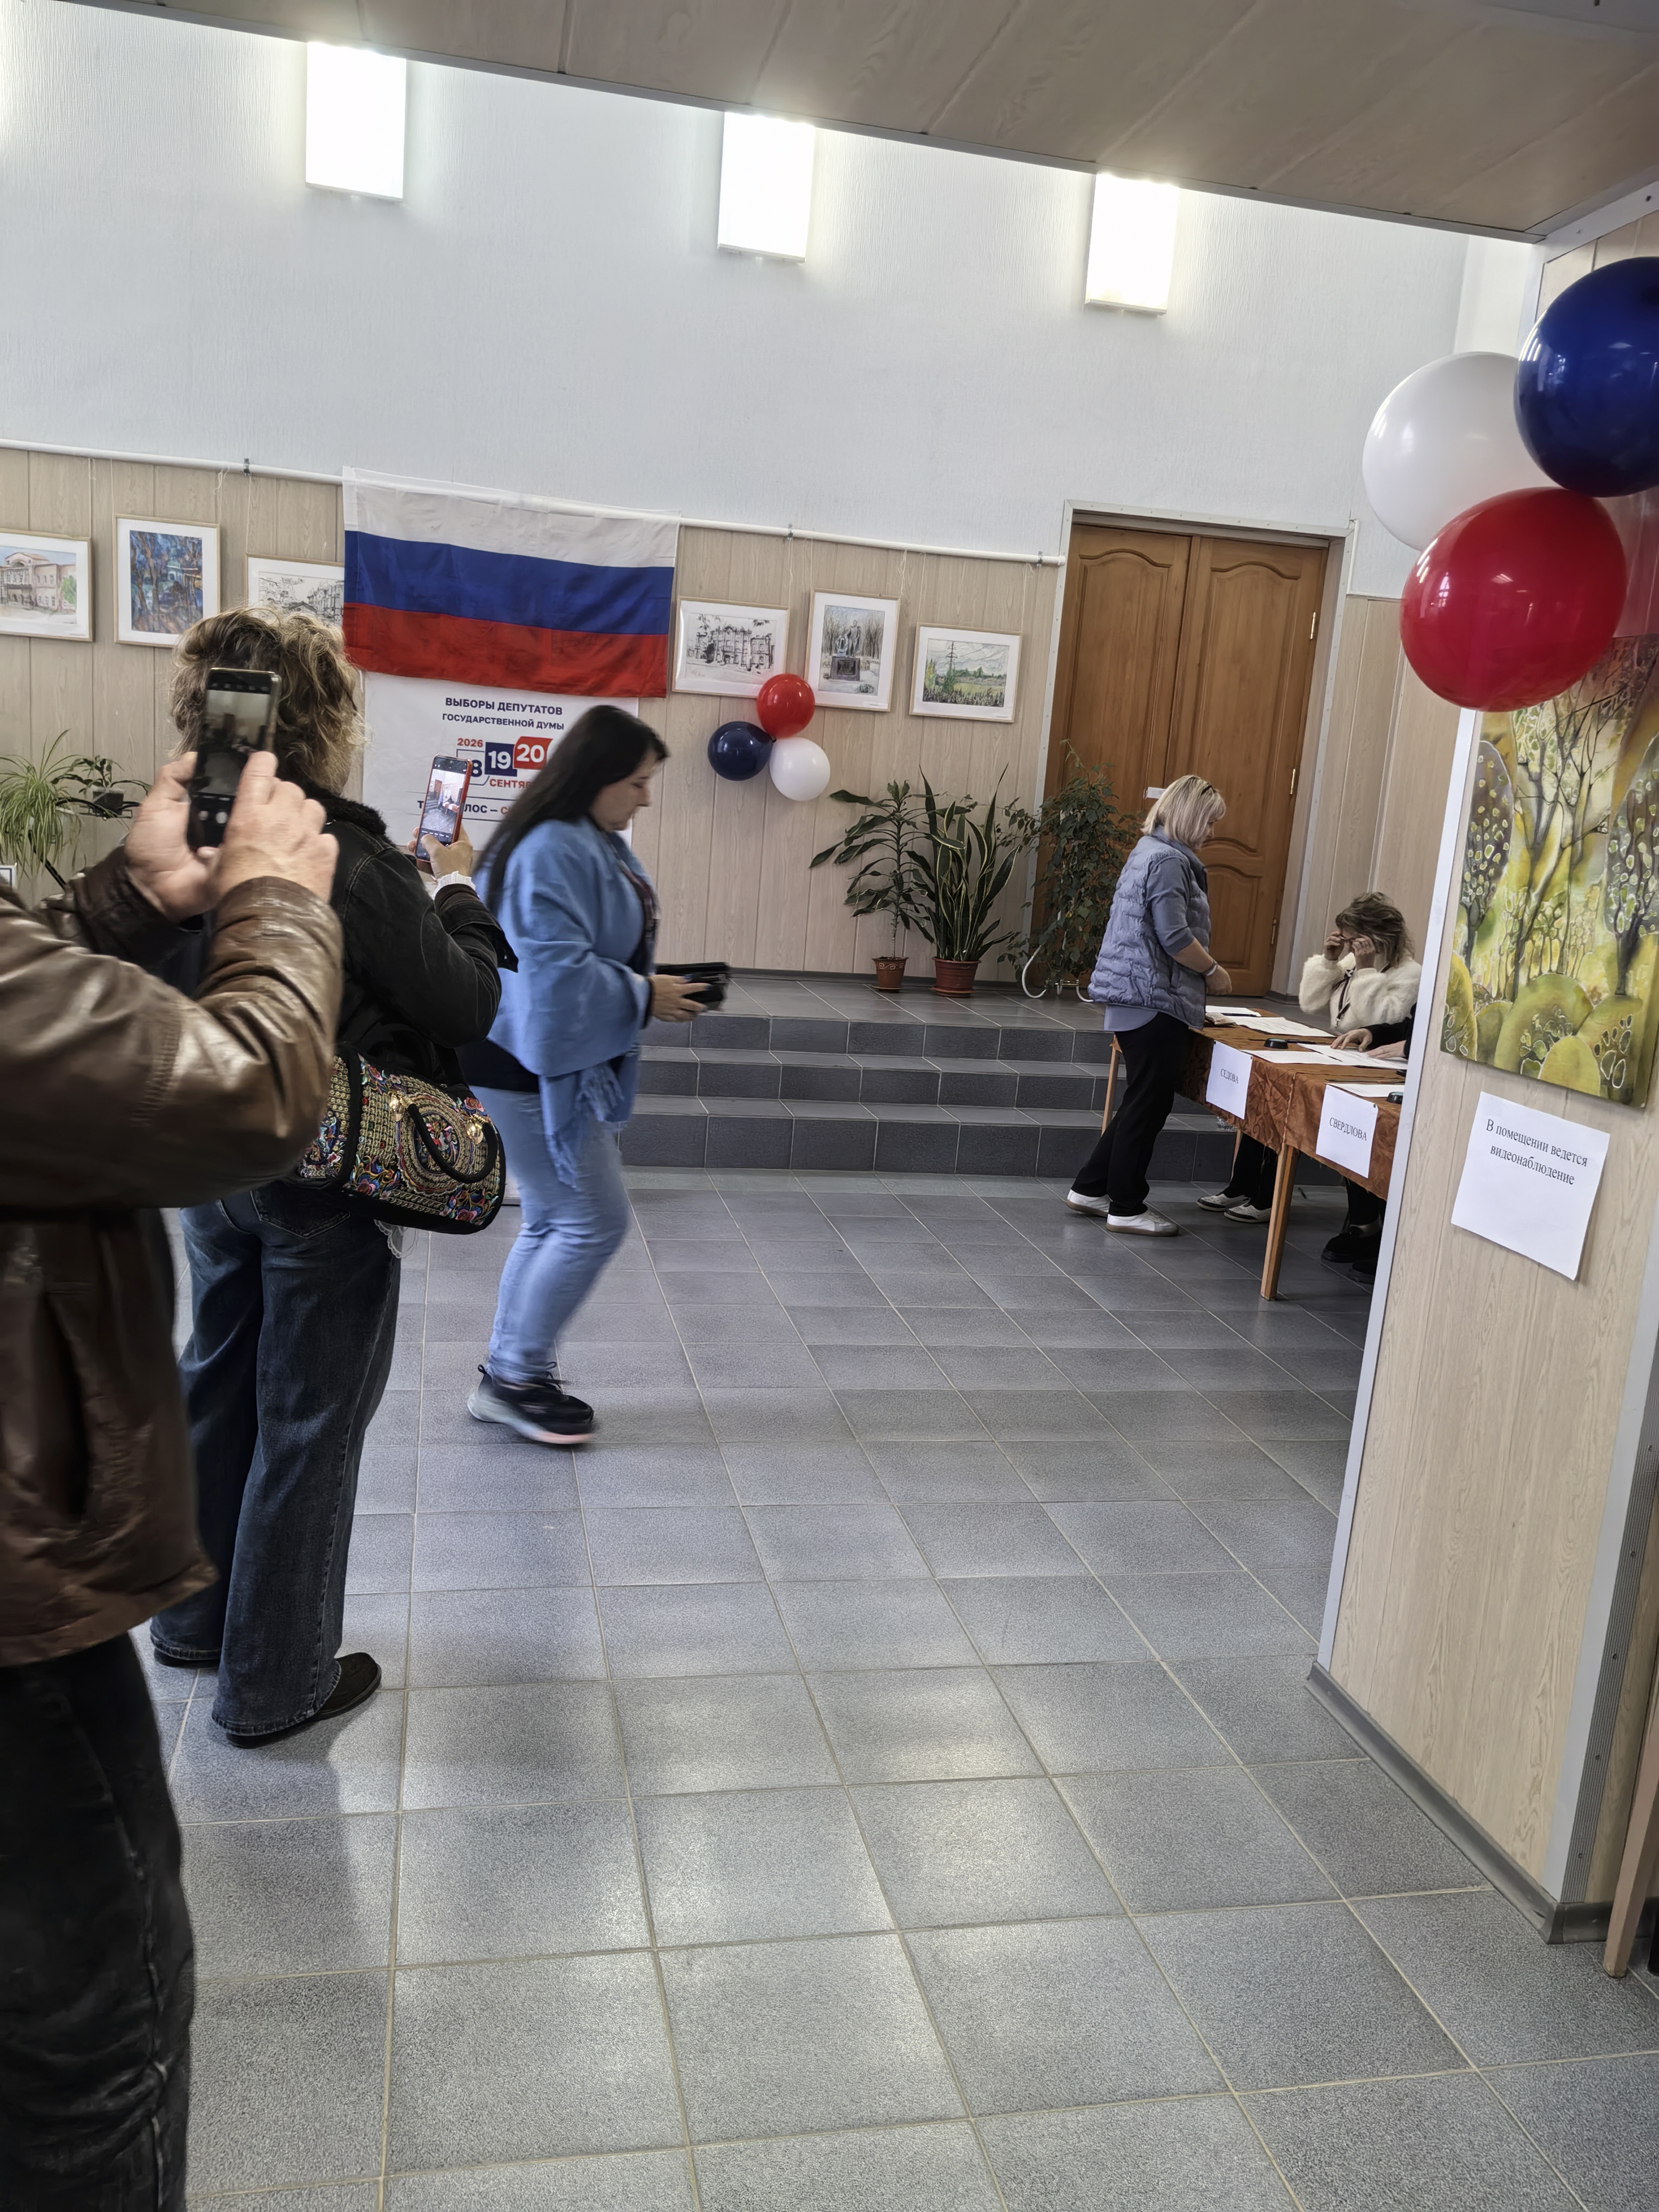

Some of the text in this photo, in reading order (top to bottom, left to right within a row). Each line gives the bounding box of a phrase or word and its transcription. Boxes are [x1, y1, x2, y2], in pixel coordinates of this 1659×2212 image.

[446, 697, 563, 715] ВЫБОРЫ ДЕПУТАТОВ
[442, 713, 564, 730] ГОСУДАРСТВЕННОЙ ДУМЫ
[457, 738, 483, 747] 2026
[470, 744, 545, 777] 8 19 20
[464, 804, 487, 813] ЛОС
[1330, 1117, 1367, 1141] СВЕРДЛОВА
[1486, 1118, 1588, 1167] В помещении ведется
[1489, 1145, 1575, 1185] видеонаблюдение
